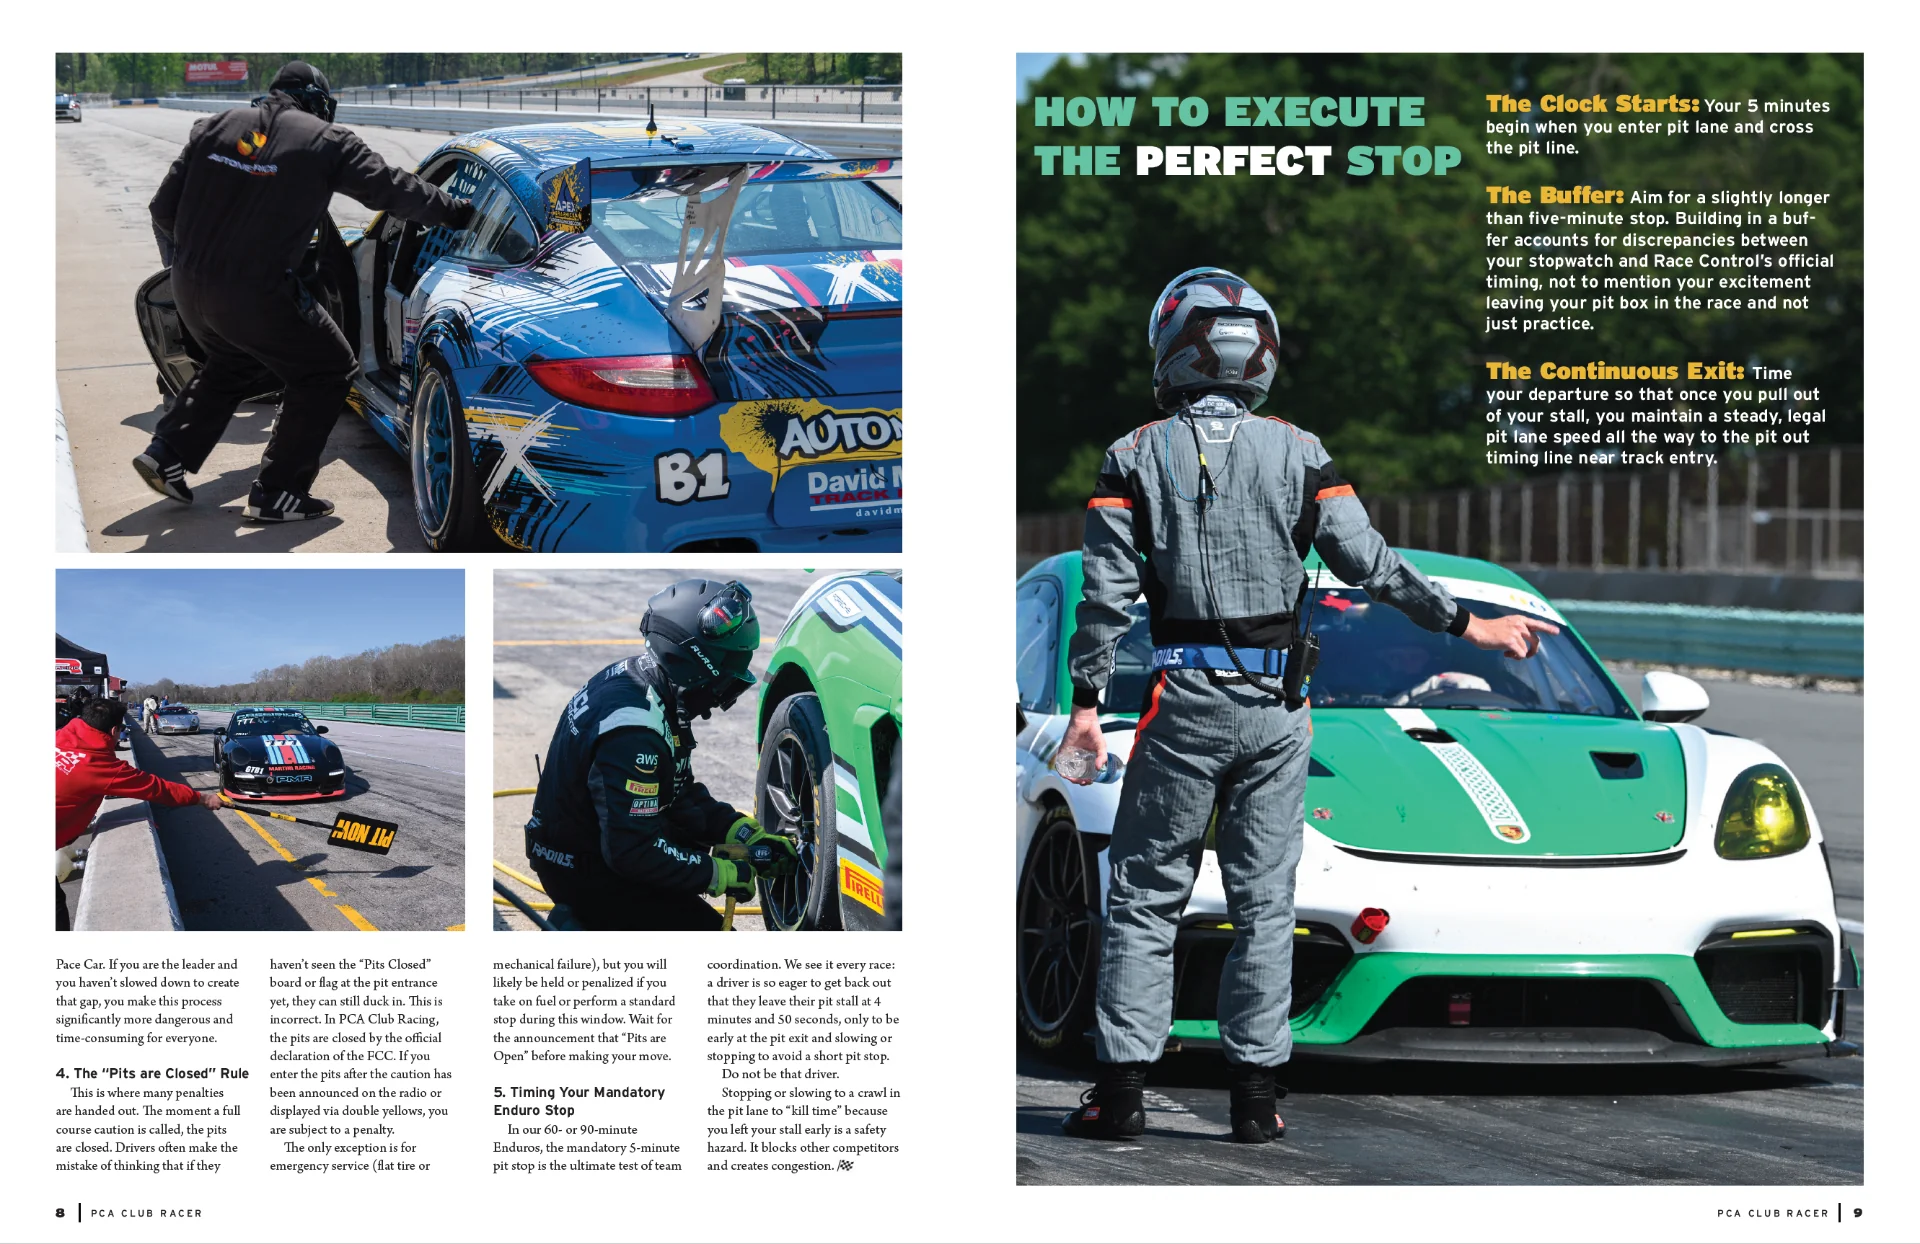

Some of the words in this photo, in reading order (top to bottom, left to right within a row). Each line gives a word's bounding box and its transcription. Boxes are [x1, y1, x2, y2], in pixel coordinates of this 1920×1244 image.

[188, 63, 218, 71] MOTUL
[555, 200, 576, 213] APEX
[658, 452, 730, 502] B1
[807, 466, 885, 495] David
[809, 490, 889, 505] TRACK
[635, 753, 659, 765] aws
[245, 765, 264, 774] GTB1
[276, 774, 313, 783] PMR
[368, 827, 395, 848] PIT
[311, 962, 336, 970] seen
[338, 958, 356, 970] the
[493, 958, 555, 970] mechanical
[557, 957, 600, 973] failure),
[602, 958, 621, 970] but
[623, 962, 644, 973] you
[646, 958, 667, 970] will
[707, 958, 782, 970] coordination.
[783, 958, 802, 970] We
[805, 962, 823, 970] see
[825, 959, 834, 970] it
[836, 962, 867, 973] every
[868, 962, 895, 970] race:
[55, 980, 76, 991] you
[119, 976, 158, 988] slowed
[160, 976, 191, 988] down
[193, 979, 205, 988] to
[207, 979, 240, 988] create
[270, 1014, 322, 1024] incorrect.
[324, 1013, 336, 1024] In
[338, 1013, 365, 1024] PCA
[368, 1013, 395, 1024] Club
[397, 1013, 439, 1028] Racing,
[55, 1033, 145, 1047] time-consuming
[146, 1031, 163, 1043] for
[165, 1035, 217, 1047] everyone.
[531, 1049, 566, 1061] before
[568, 1049, 610, 1065] making
[611, 1053, 637, 1065] your
[638, 1053, 672, 1061] move.
[55, 1067, 70, 1079] 4.
[73, 1067, 98, 1079] The
[140, 1069, 162, 1079] are
[220, 1067, 250, 1079] Rule
[722, 1068, 740, 1079] Do
[742, 1070, 761, 1079] not
[763, 1067, 777, 1079] be
[780, 1067, 802, 1079] that
[804, 1067, 840, 1079] driver.
[493, 1086, 506, 1098] 5.
[510, 1086, 555, 1101] Timing
[559, 1086, 590, 1098] Your
[594, 1086, 666, 1101] Mandatory
[494, 1104, 541, 1116] Enduro
[545, 1104, 575, 1118] Stop
[507, 1123, 520, 1135] In
[522, 1127, 542, 1135] our
[544, 1124, 563, 1135] 60-
[565, 1127, 578, 1135] or
[580, 1124, 638, 1135] 90-minute
[55, 1207, 66, 1218] 8
[91, 1209, 115, 1218] PCA
[121, 1209, 153, 1218] CLUB
[160, 1209, 202, 1218] RACER
[1717, 1209, 1741, 1218] PCA
[1748, 1209, 1780, 1218] CLUB
[1786, 1209, 1828, 1218] RACER
[1853, 1207, 1863, 1218] 9
